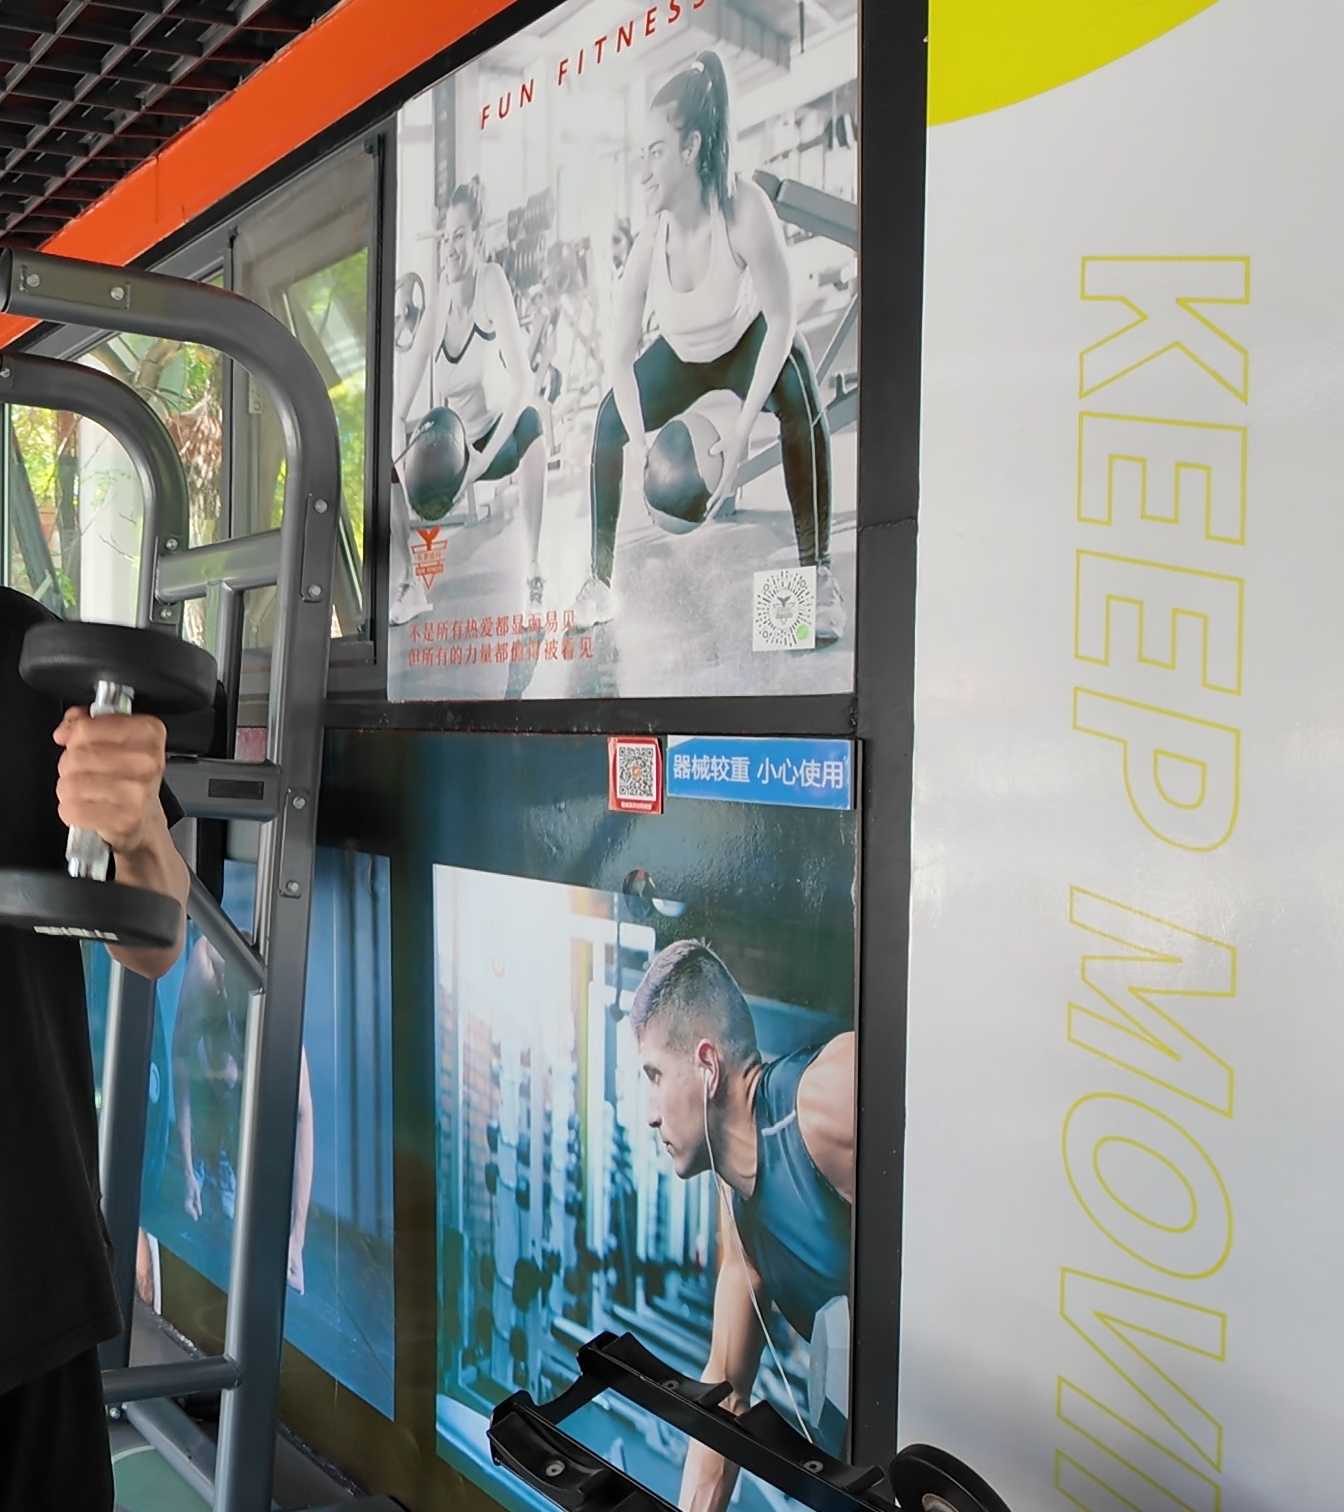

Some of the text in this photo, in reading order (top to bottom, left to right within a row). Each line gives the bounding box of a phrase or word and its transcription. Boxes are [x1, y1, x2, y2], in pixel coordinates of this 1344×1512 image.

[480, 78, 535, 131] FUN
[673, 754, 844, 789] 器械较重 小心使用
[1054, 255, 1251, 1512] KEEP MOVI
